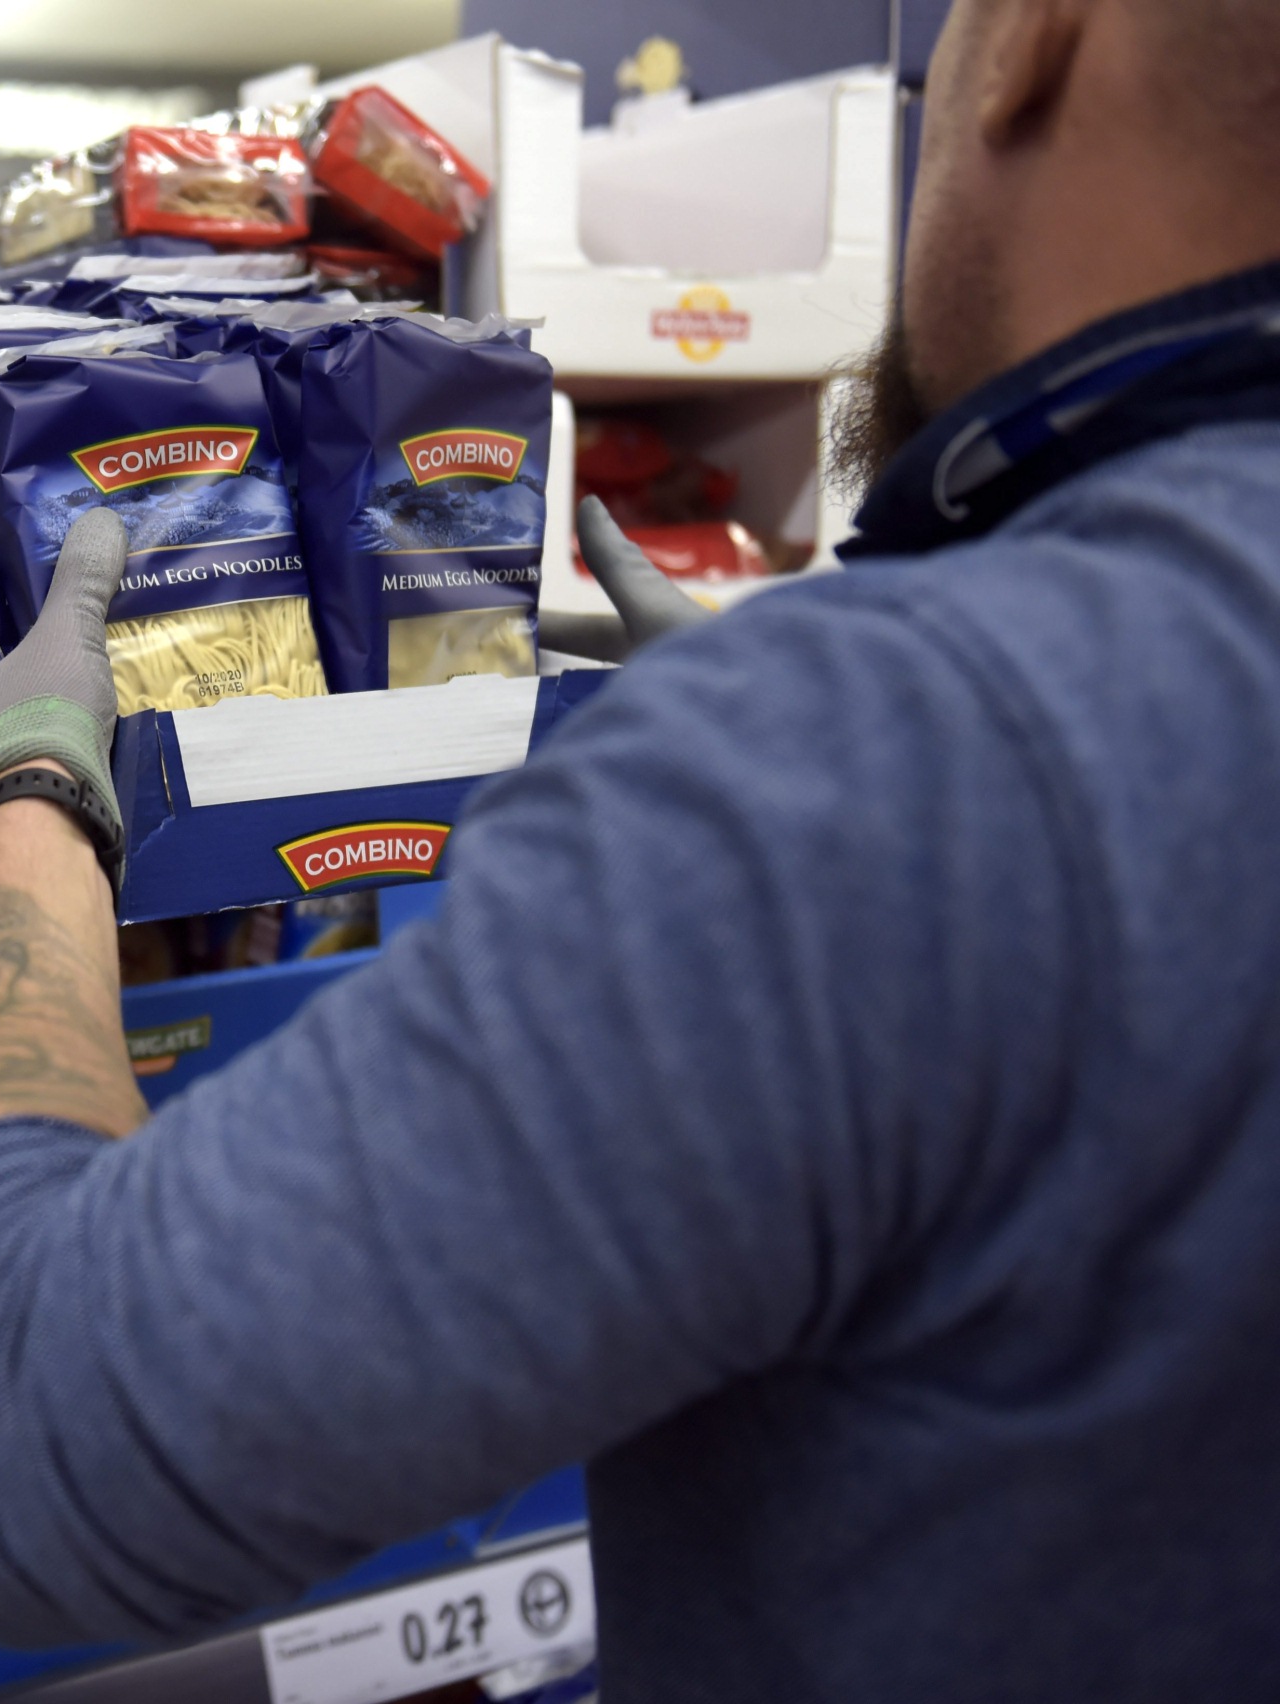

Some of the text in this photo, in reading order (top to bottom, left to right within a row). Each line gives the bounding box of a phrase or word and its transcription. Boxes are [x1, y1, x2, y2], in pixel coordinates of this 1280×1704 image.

[98, 440, 239, 478] COMBINO
[416, 443, 513, 471] COMBINO
[121, 555, 303, 592] IUM EGG NOODLES
[381, 566, 539, 592] MEDIUM EGG NOODLES
[195, 669, 242, 685] 10/2020
[198, 682, 244, 697] 61974B
[305, 838, 433, 876] COMBINO
[402, 1594, 488, 1663] 0.27
